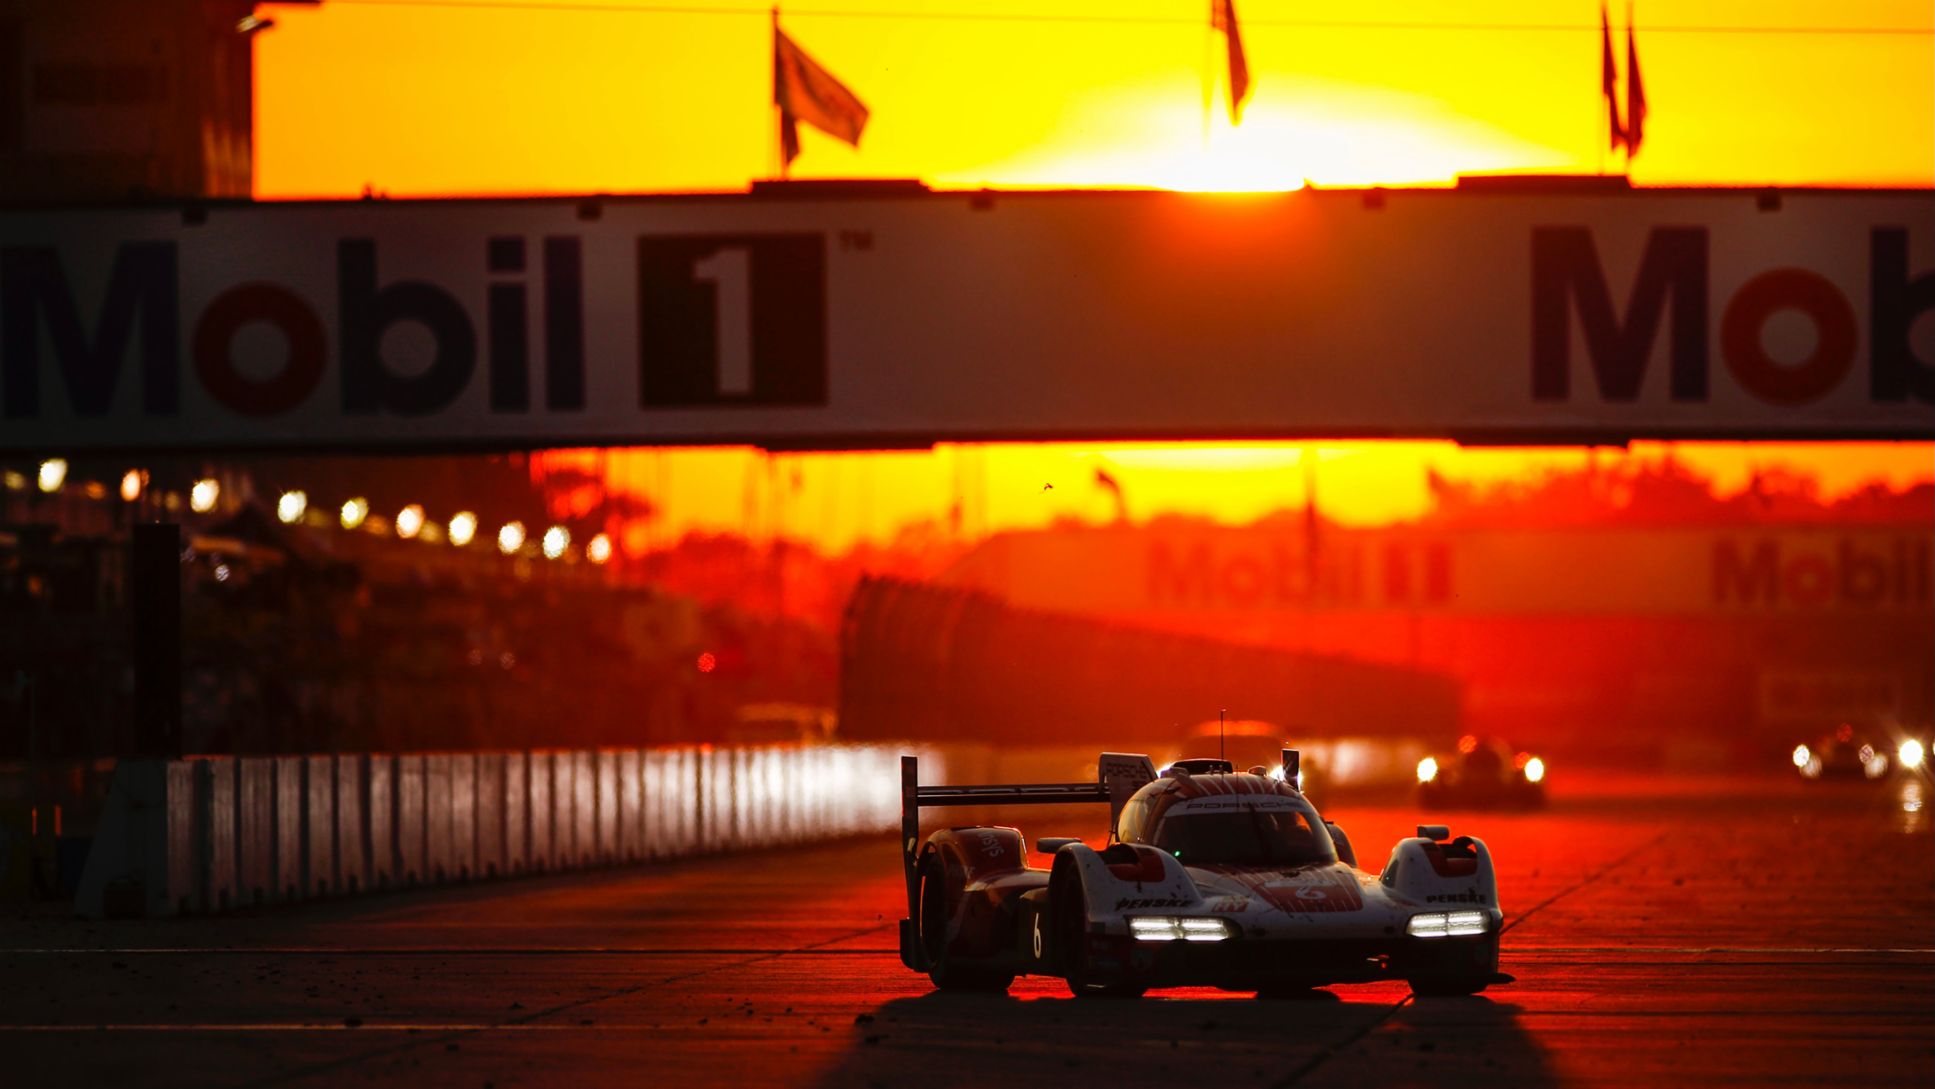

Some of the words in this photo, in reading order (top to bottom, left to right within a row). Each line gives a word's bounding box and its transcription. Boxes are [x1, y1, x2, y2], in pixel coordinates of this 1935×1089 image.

[0, 236, 586, 418] Mobil
[691, 246, 756, 397] 1
[1713, 539, 1932, 603] Mobil
[1114, 897, 1194, 911] PENSKE
[1295, 885, 1328, 900] 6
[1426, 893, 1487, 904] PENSKE
[1033, 911, 1043, 959] 6
